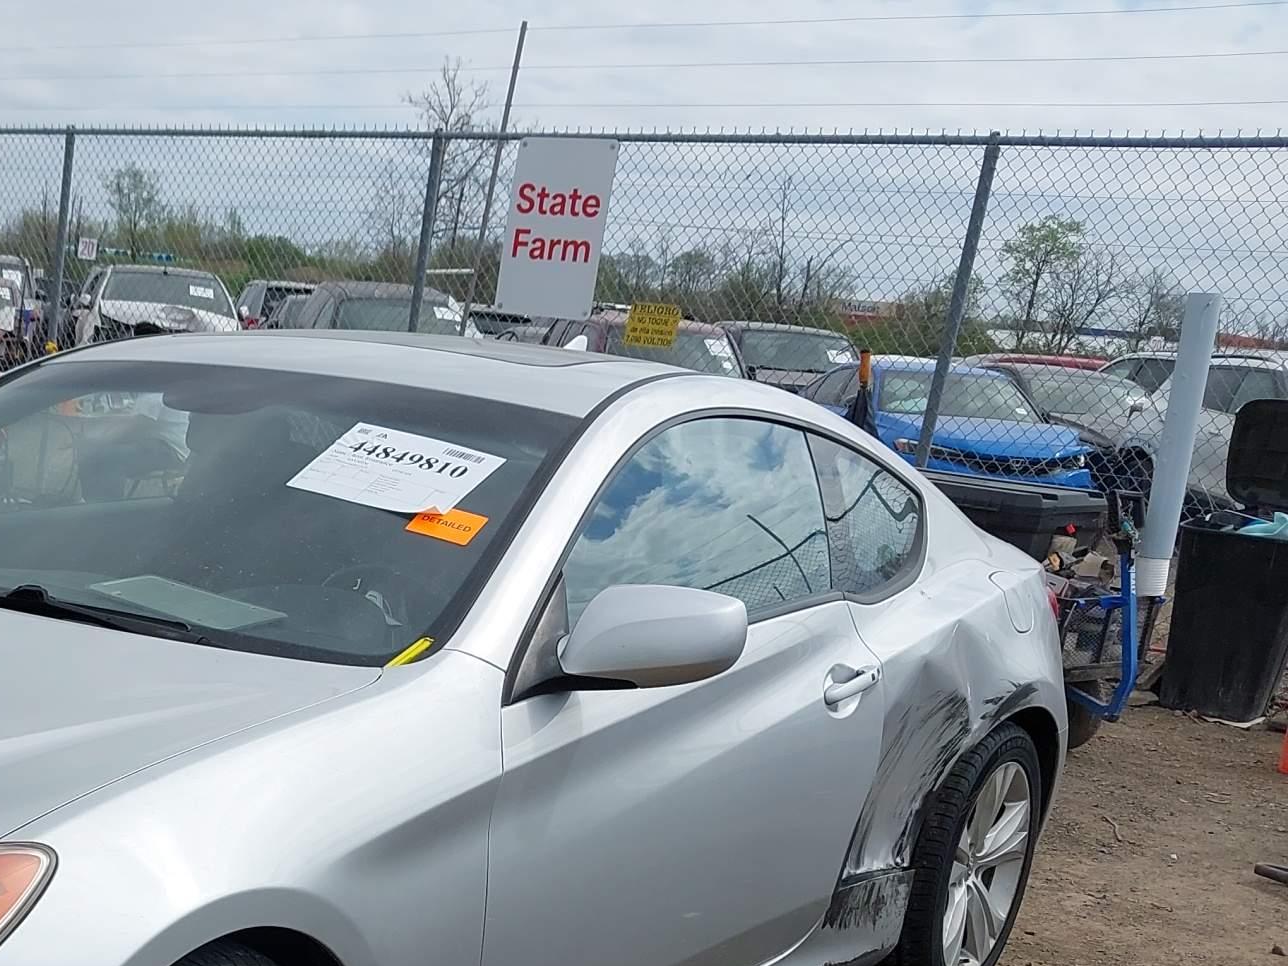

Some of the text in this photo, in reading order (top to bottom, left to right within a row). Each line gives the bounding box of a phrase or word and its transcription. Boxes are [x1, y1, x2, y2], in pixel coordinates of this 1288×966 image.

[516, 183, 601, 218] State
[511, 228, 592, 263] Farm
[348, 440, 468, 480] 44849810
[422, 515, 472, 533] DETAILED
